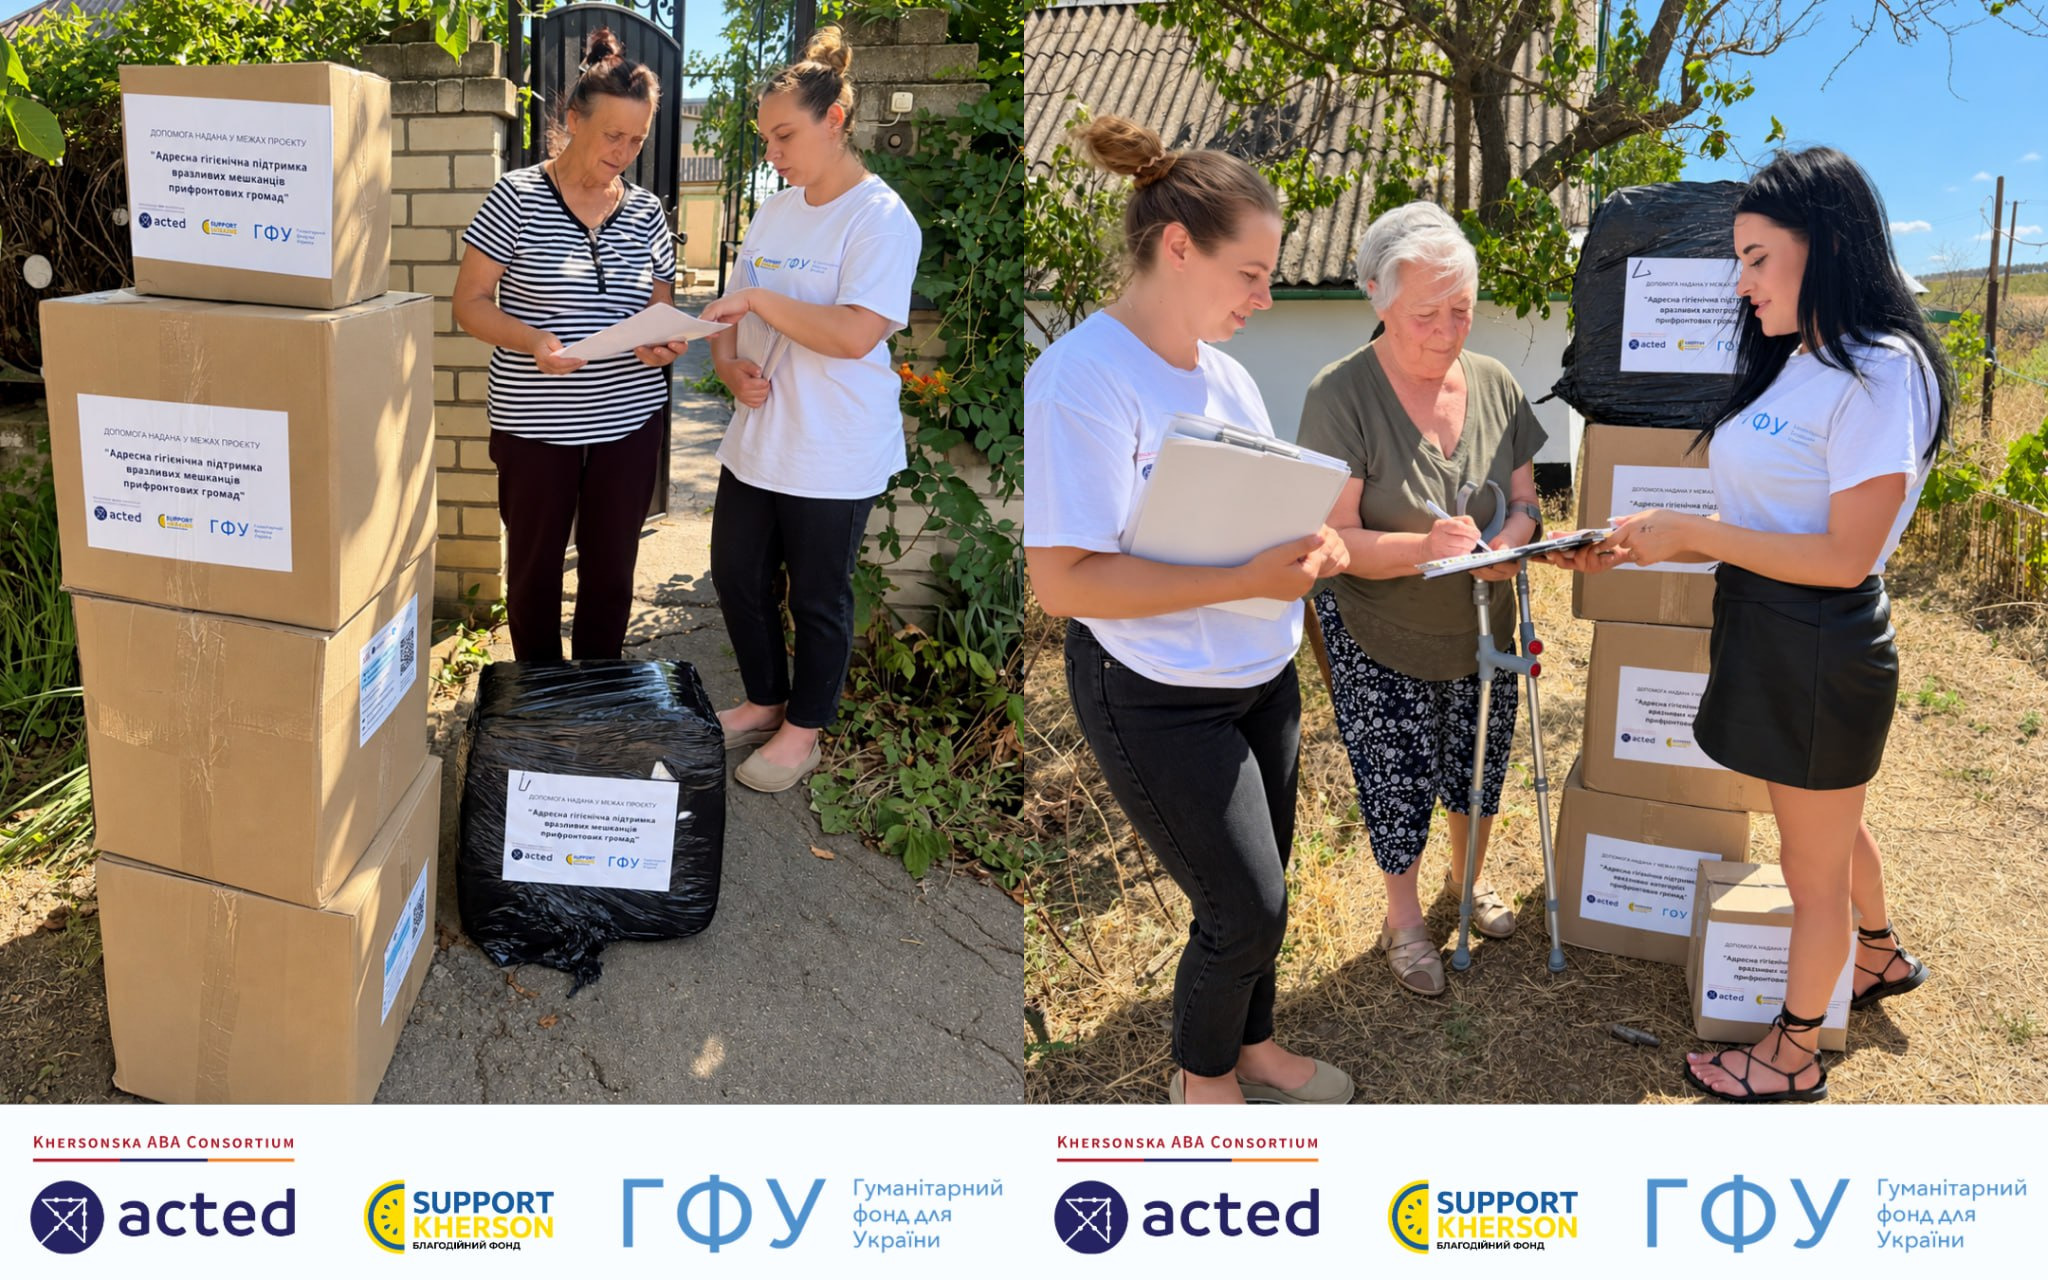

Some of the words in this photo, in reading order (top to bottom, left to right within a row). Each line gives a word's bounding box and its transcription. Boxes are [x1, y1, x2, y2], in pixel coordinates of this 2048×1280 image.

[150, 129, 193, 139] ДОПОМОГА
[195, 133, 227, 142] НАДАНА
[229, 135, 235, 143] У
[237, 135, 266, 145] МЕЖАХ
[253, 158, 307, 172] підтримка
[172, 169, 226, 181] вразливих
[229, 173, 285, 187] мешканців
[169, 183, 243, 199] прифронтових
[154, 216, 186, 229] acted
[254, 224, 292, 242] ГФУ
[1641, 341, 1666, 349] acted
[104, 428, 147, 439] ДОПОМОГА
[148, 432, 181, 442] НАДАНА
[183, 435, 188, 443] У
[191, 436, 219, 446] МЕЖАХ
[207, 458, 263, 472] підтримка
[127, 466, 181, 479] вразливих
[184, 472, 240, 485] мешканців
[124, 480, 199, 495] прифронтових
[109, 510, 142, 523] acted
[210, 519, 249, 537] ГФУ
[1632, 736, 1655, 744] acted
[525, 853, 553, 862] acted
[608, 856, 640, 869] ГФУ
[1597, 898, 1619, 907] acted
[1719, 993, 1744, 1002] acted
